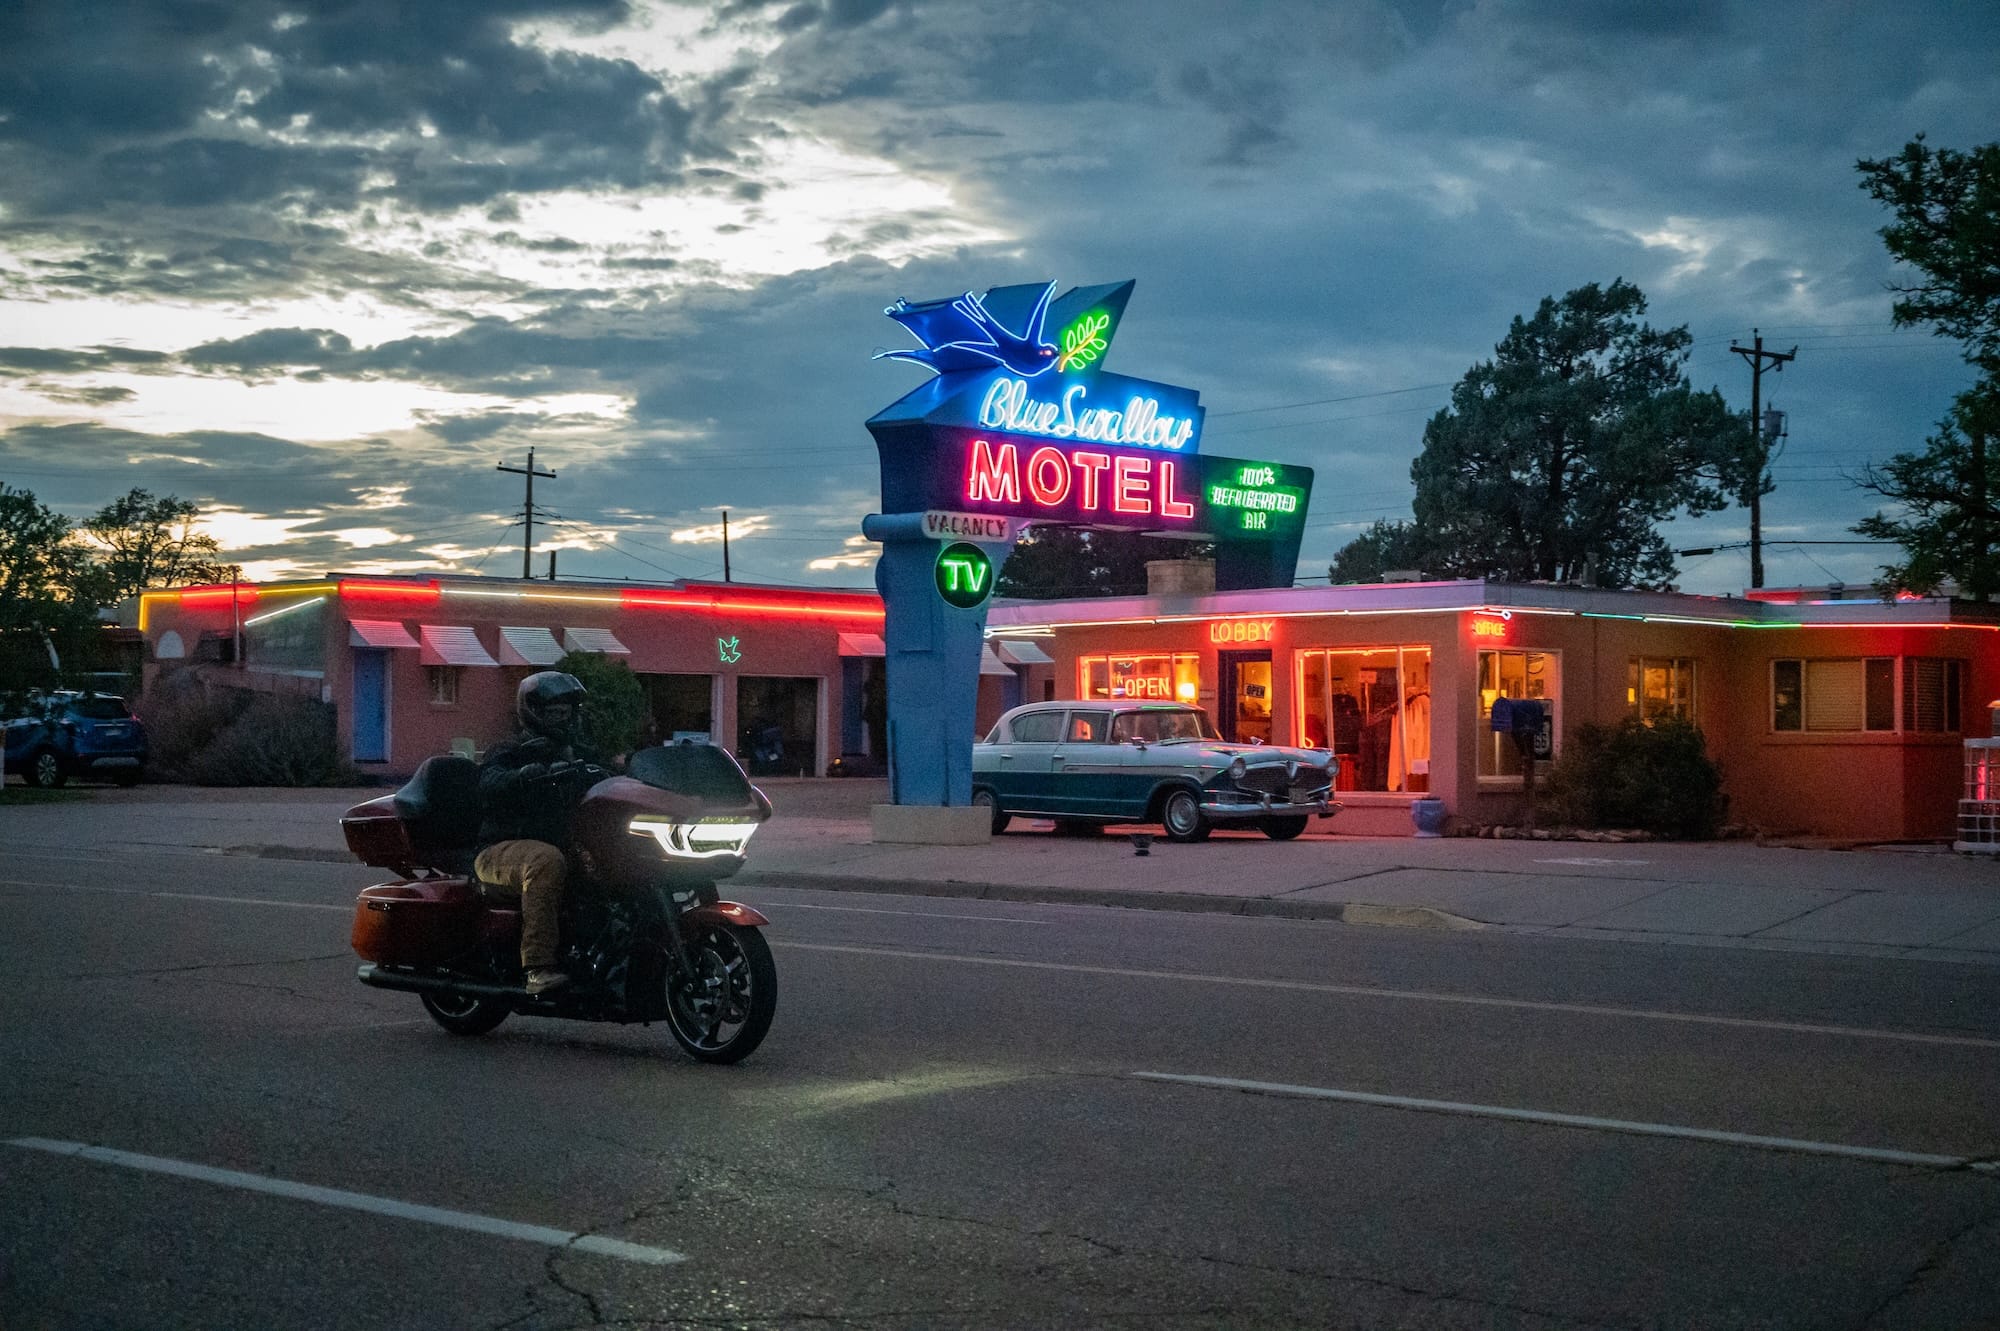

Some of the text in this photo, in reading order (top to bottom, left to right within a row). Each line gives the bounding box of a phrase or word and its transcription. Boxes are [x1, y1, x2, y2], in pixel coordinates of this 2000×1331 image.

[979, 378, 1193, 449] Blue Swallow
[969, 440, 1194, 518] MOTEL
[1240, 467, 1275, 487] 100%
[1211, 486, 1297, 512] REFRIGERATED
[926, 514, 1007, 537] VACANCY
[1243, 511, 1267, 529] AIR
[941, 559, 987, 592] TV
[1210, 622, 1273, 643] LOBBY
[1473, 620, 1506, 636] OFFICE
[1124, 676, 1170, 697] OPEN
